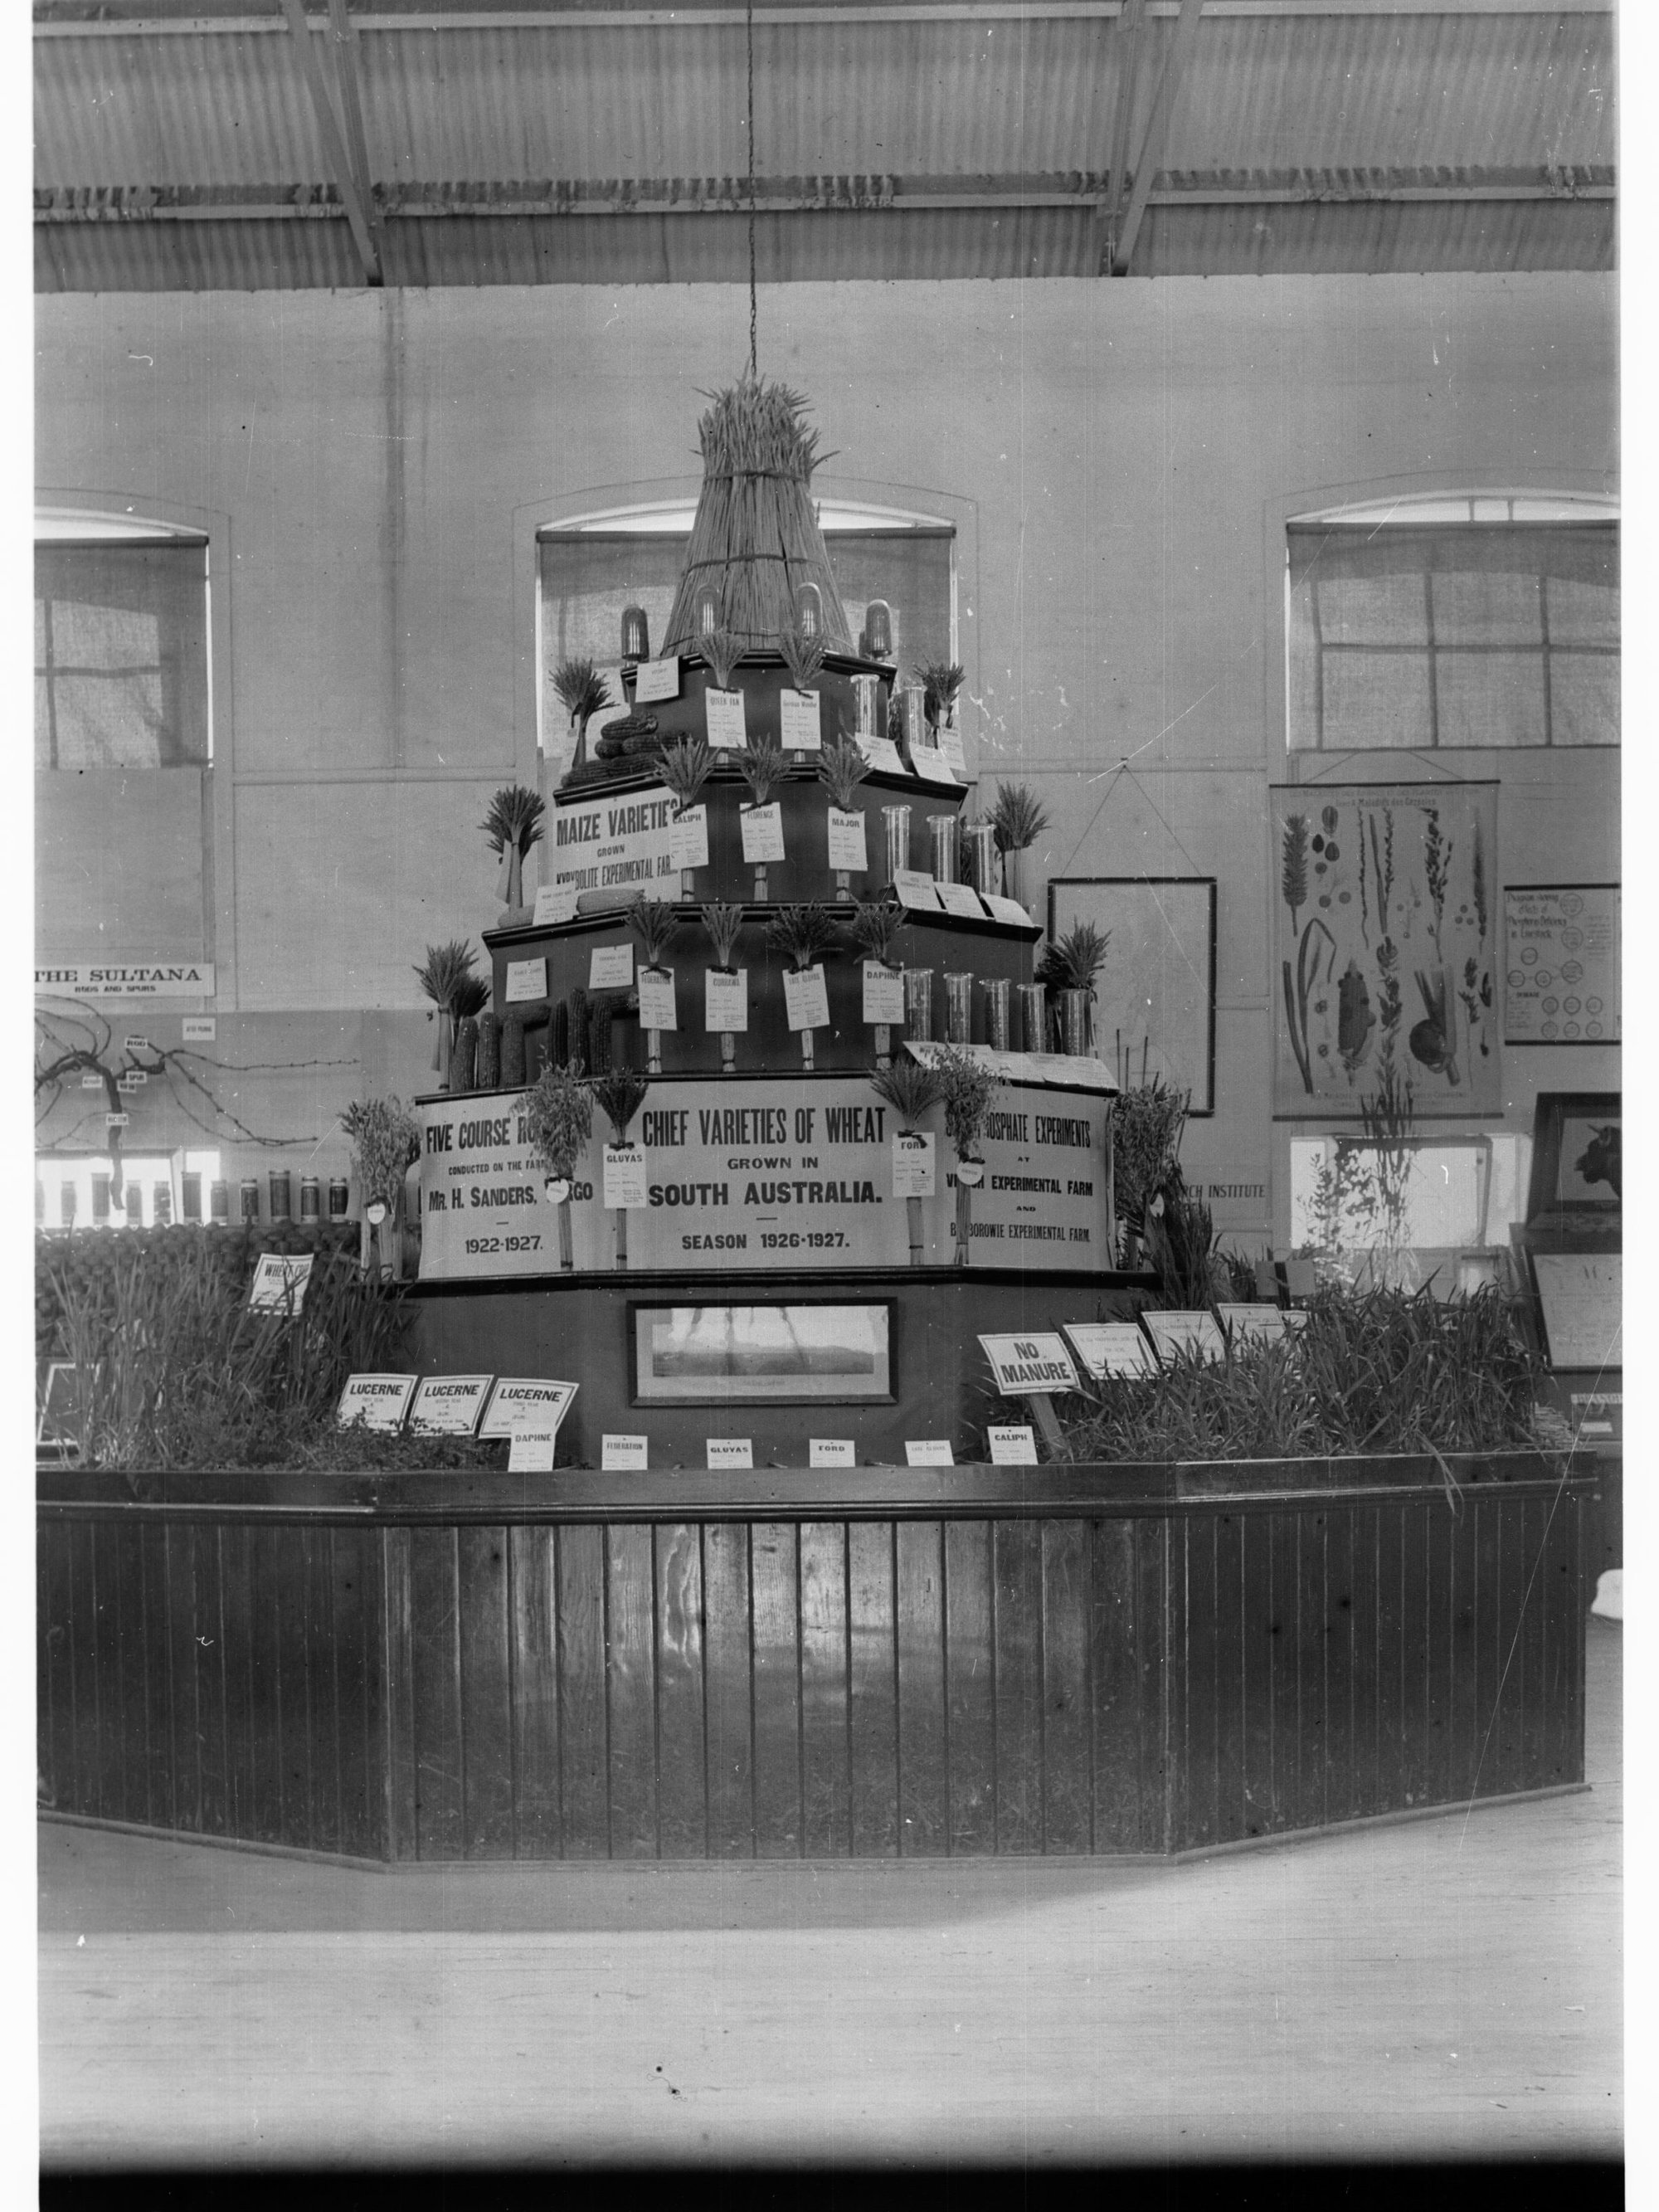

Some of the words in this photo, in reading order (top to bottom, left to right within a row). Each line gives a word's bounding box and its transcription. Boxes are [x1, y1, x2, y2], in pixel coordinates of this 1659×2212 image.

[557, 813, 601, 846] MAIZE
[831, 818, 861, 828] MAJOR
[596, 844, 625, 857] GROWN
[601, 857, 654, 886] EXPERIMENTAL
[657, 854, 679, 877] FAR
[90, 968, 202, 982] SULTANA
[866, 971, 901, 980] DAPHNE
[104, 985, 123, 993] AND
[126, 984, 157, 993] SPURS
[641, 1110, 689, 1147] CHIEF
[698, 1107, 787, 1146] VARIETIES
[794, 1107, 816, 1144] OF
[825, 1106, 886, 1144] WHEAT
[1035, 1114, 1092, 1148] EXPERIMENTS
[426, 1123, 454, 1154] FIVE
[459, 1117, 511, 1150] COURSE
[901, 1140, 923, 1150] FOR
[606, 1154, 643, 1163] GLUYAS
[727, 1156, 792, 1171] GROWN
[801, 1156, 819, 1170] IN
[448, 1162, 489, 1176] CONDUCTED
[493, 1162, 504, 1172] ON
[507, 1161, 523, 1171] THE
[648, 1182, 729, 1206] SOUTH
[744, 1180, 883, 1205] AUSTRALIA.
[990, 1175, 1063, 1194] EXPERIMENTAL
[1067, 1180, 1093, 1196] FARM
[1208, 1184, 1266, 1198] INSTITUTE
[451, 1187, 465, 1209] H.
[470, 1184, 538, 1209] SANDERS,
[950, 1222, 1005, 1238] BBOROWIE
[1009, 1224, 1067, 1241] EXPERIMENTAL
[681, 1234, 747, 1250] SEASON
[1013, 1342, 1040, 1360] NO
[1000, 1361, 1071, 1383] MANURE
[349, 1383, 404, 1396] LUCERNE
[424, 1384, 480, 1397] LUCERNE
[499, 1388, 563, 1403] LUCERNE
[515, 1433, 552, 1443] DAPHNE
